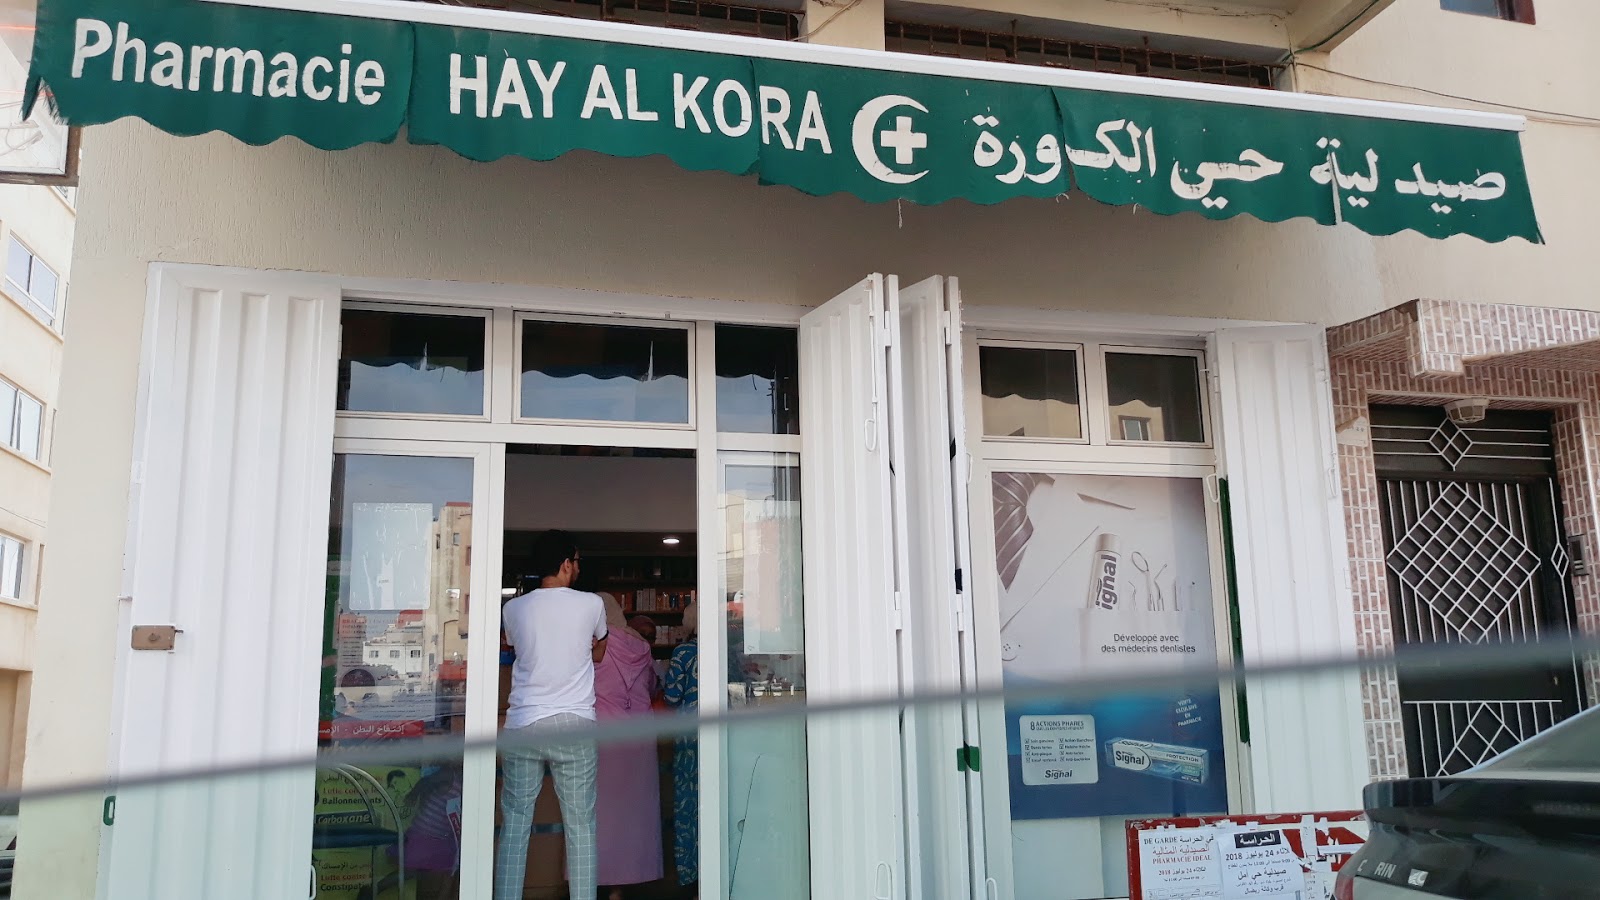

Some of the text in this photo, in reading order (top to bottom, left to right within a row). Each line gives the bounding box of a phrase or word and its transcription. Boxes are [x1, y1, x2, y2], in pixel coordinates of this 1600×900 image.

[71, 18, 385, 105] Pharmacie
[449, 53, 832, 154] HAY AL KORA
[1095, 554, 1118, 610] ignal
[1113, 633, 1158, 643] Développé
[1101, 644, 1196, 653] des médecins dentistes
[1030, 721, 1036, 731] 8
[1115, 750, 1145, 765] Signal
[1166, 753, 1199, 763] PROTECTION
[1044, 769, 1073, 779] Signal
[1154, 836, 1178, 845] GARDE
[1239, 832, 1276, 846] الحراسة
[1225, 852, 1243, 861] 2018
[1264, 849, 1274, 857] 24
[1152, 854, 1212, 865] PHARMACIE IDEAL
